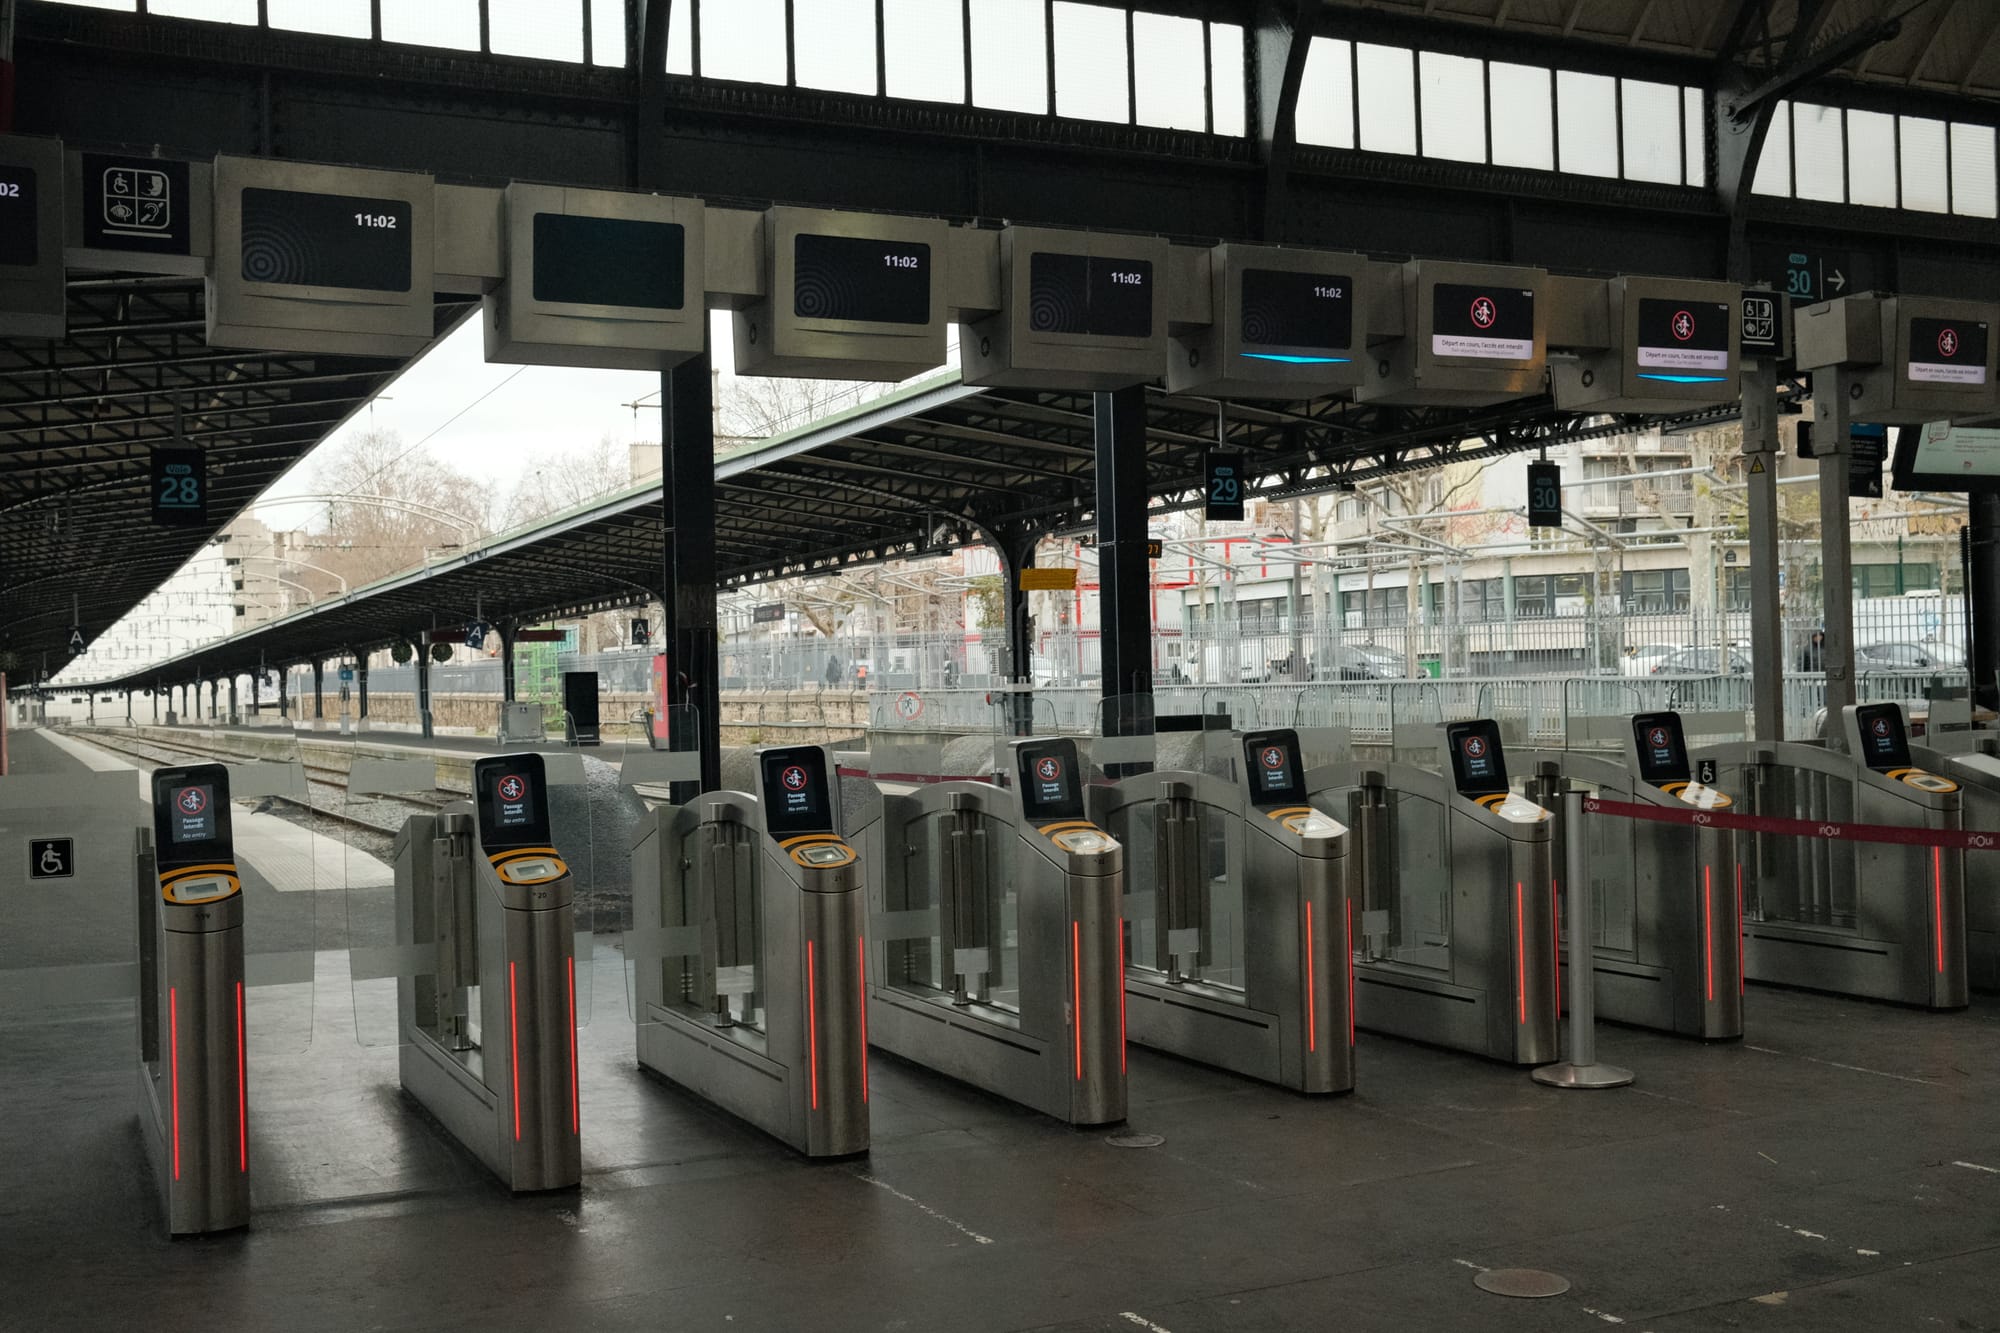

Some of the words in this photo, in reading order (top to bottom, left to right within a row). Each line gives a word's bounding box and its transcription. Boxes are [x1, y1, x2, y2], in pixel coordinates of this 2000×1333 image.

[355, 214, 396, 228] 11:02
[884, 255, 918, 268] 11:02
[1112, 272, 1142, 284] 11:02
[1787, 270, 1810, 293] 30
[1314, 287, 1342, 298] 11:02
[160, 477, 199, 503] 28
[1212, 478, 1238, 501] 29
[1534, 488, 1556, 508] 30
[470, 626, 482, 639] A
[634, 623, 645, 635] A
[70, 630, 83, 644] A
